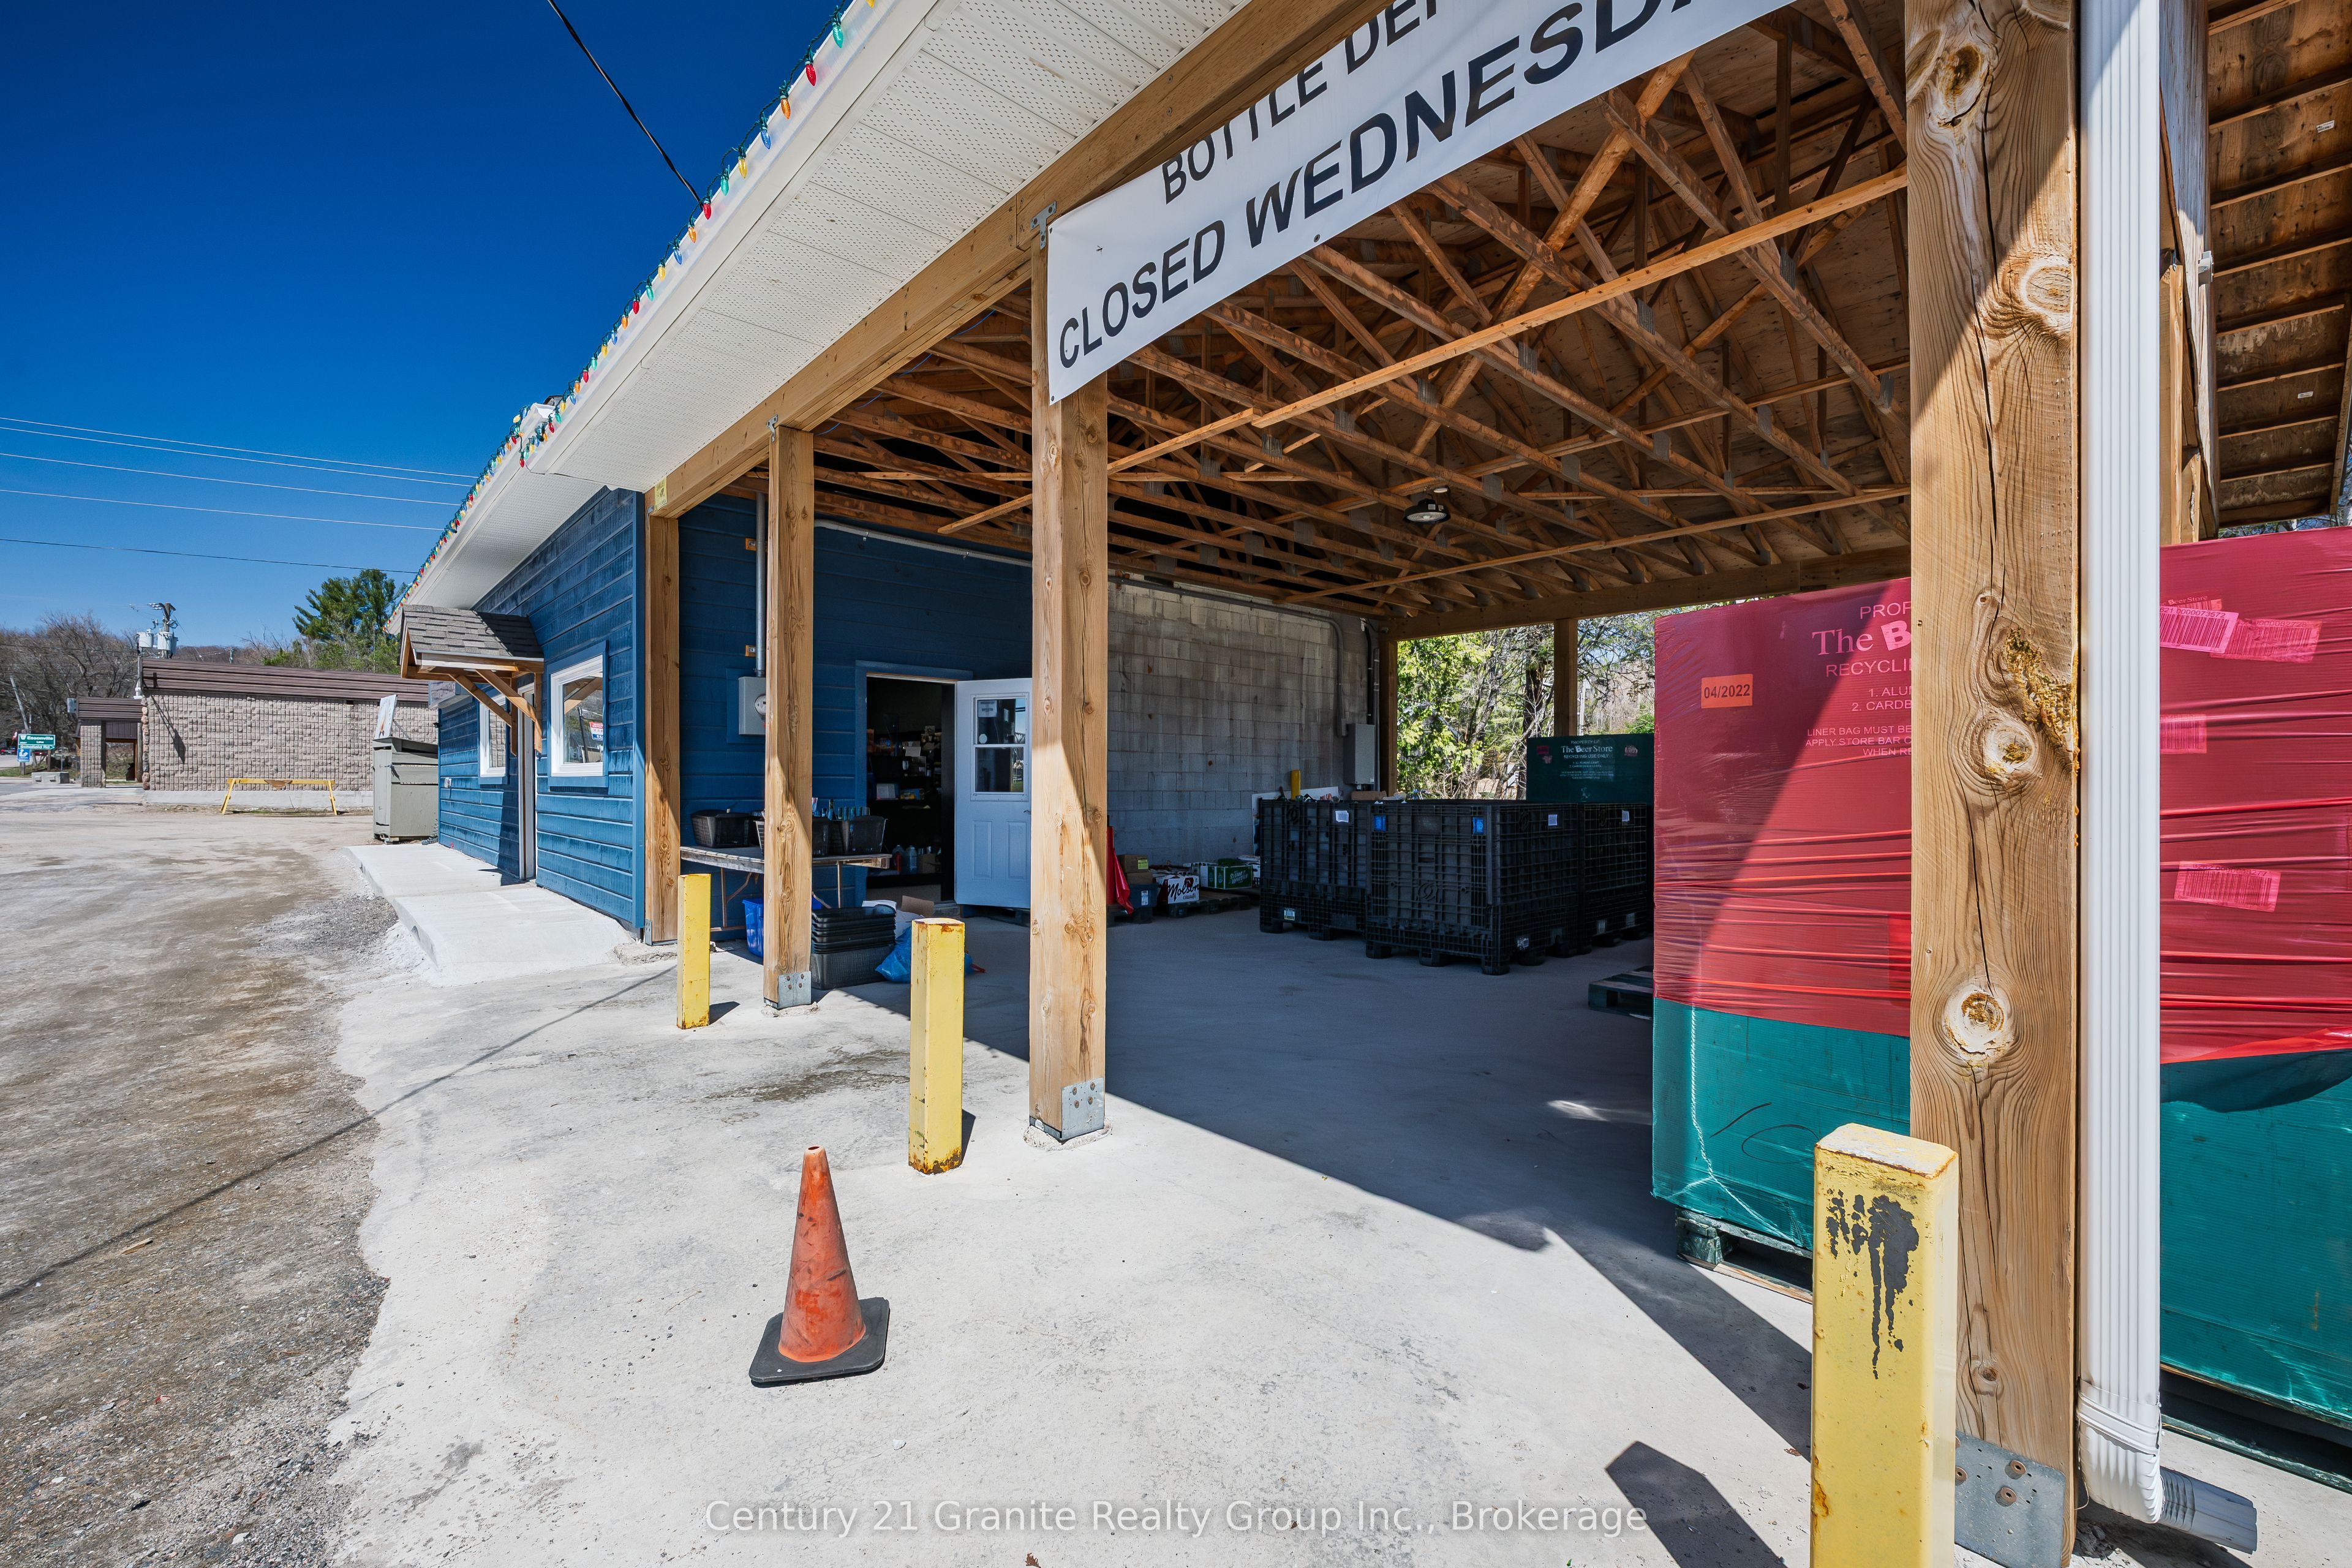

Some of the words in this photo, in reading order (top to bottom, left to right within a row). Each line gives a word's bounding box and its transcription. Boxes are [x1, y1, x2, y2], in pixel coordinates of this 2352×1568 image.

[1161, 61, 1328, 205] BOTTLE
[1059, 219, 1226, 369] CLOSED
[1245, 0, 1692, 249] WEDNESD
[1812, 628, 1874, 655] The
[1826, 658, 1912, 677] RECYCLI
[1704, 684, 1751, 699] 04/2022
[1868, 688, 1879, 697] 1.
[1882, 686, 1912, 696] ALU
[1852, 703, 1862, 712] 2.
[1807, 728, 1836, 736] LINER
[1839, 726, 1861, 736] BAG
[1864, 726, 1894, 734] MUST
[1839, 737, 1874, 745] STORE
[1878, 736, 1900, 745] BAR
[1167, 877, 1199, 902] Molson
